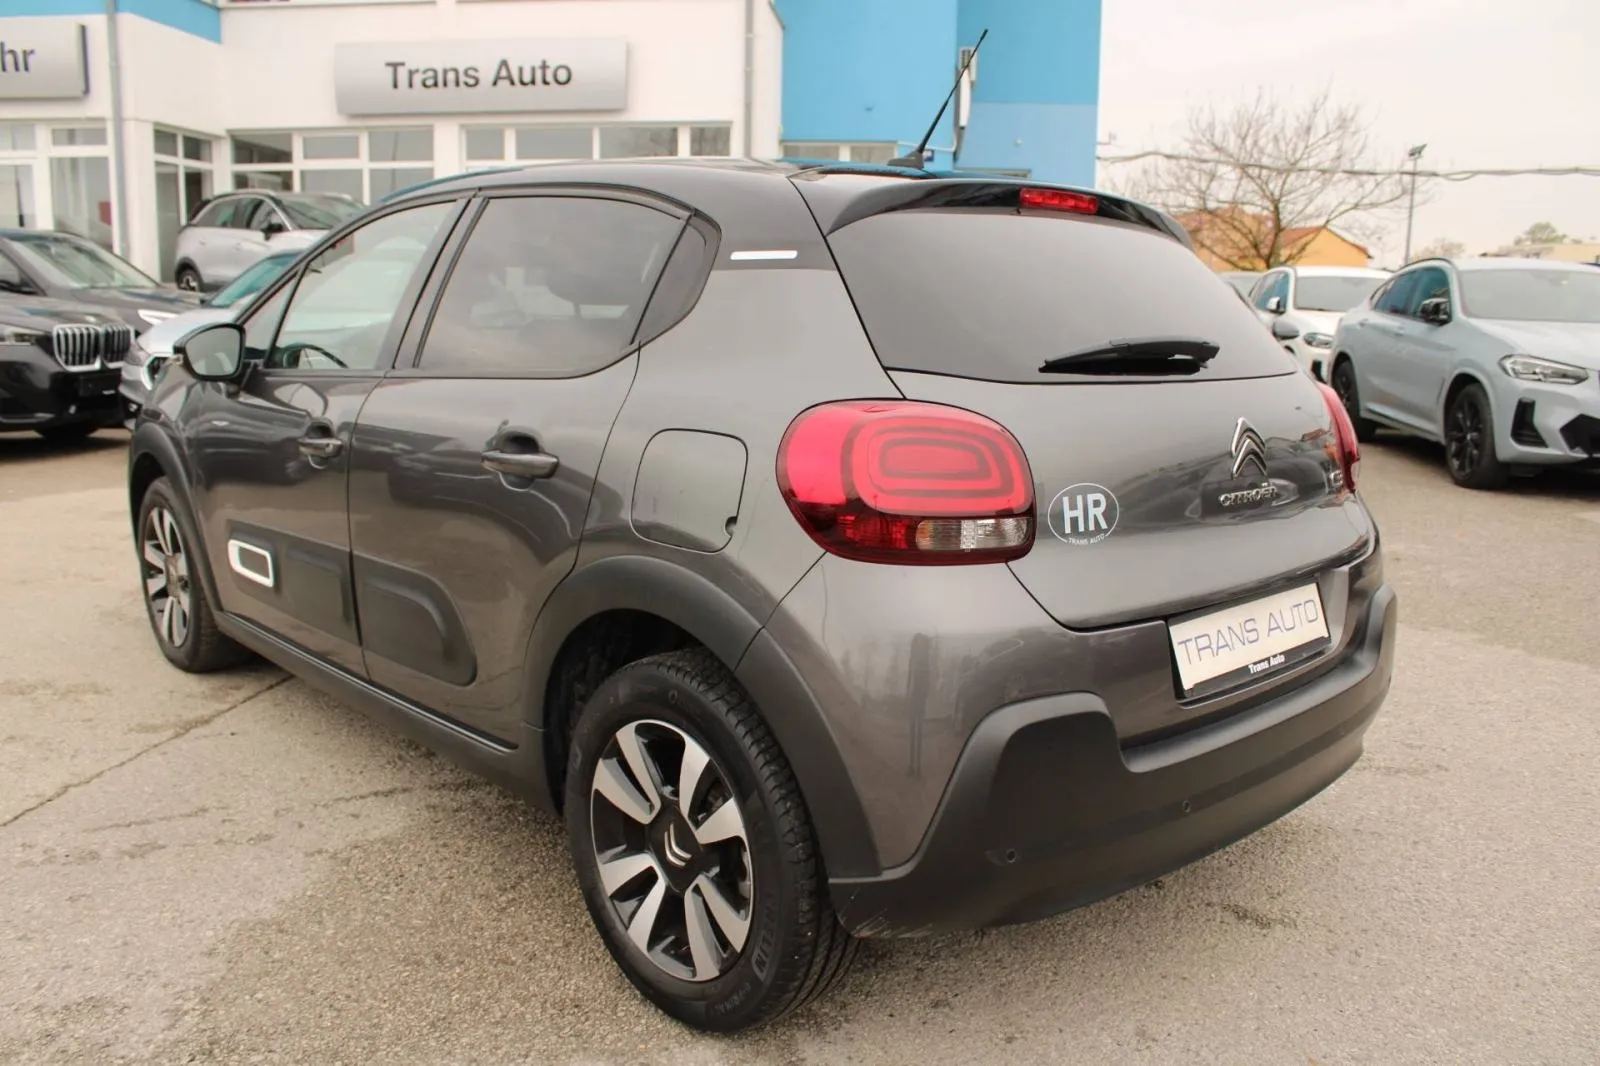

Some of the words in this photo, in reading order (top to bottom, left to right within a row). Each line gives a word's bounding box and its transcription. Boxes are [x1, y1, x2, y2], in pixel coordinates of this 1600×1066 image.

[385, 61, 480, 89] Trans
[492, 59, 573, 87] Auto
[1062, 492, 1109, 534] HR
[1068, 537, 1089, 546] TRANS
[1090, 533, 1105, 544] AUTO
[1177, 618, 1260, 665] TRANS
[1267, 599, 1319, 637] AUTO
[1248, 660, 1269, 674] Trans
[1270, 654, 1285, 667] Auto
